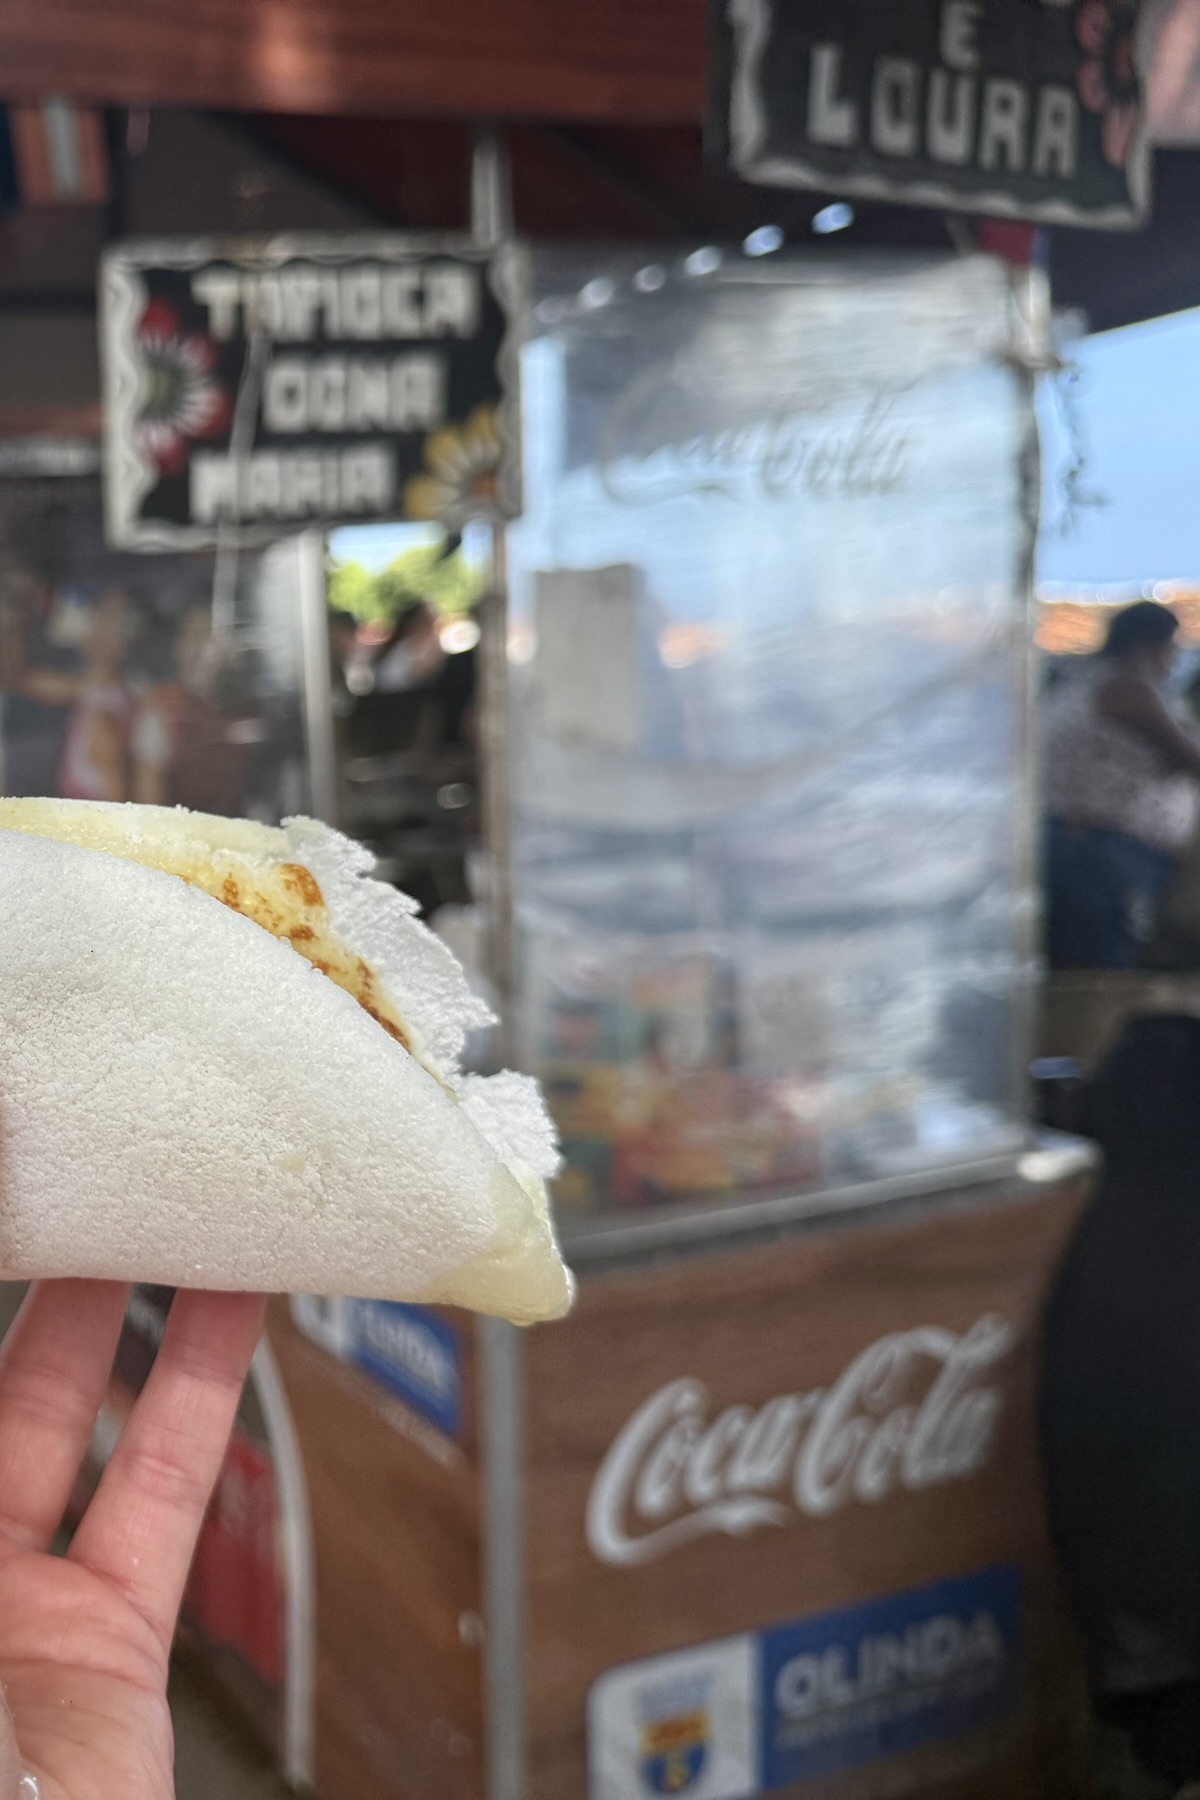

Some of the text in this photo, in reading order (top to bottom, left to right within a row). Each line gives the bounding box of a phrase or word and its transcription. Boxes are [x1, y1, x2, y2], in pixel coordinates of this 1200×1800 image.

[940, 0, 982, 67] E
[807, 42, 1078, 178] LOURA
[192, 266, 479, 341] TAPIOCA
[265, 352, 445, 432] DONA
[190, 445, 393, 522] MARIA
[776, 1612, 1002, 1715] OLINDA
